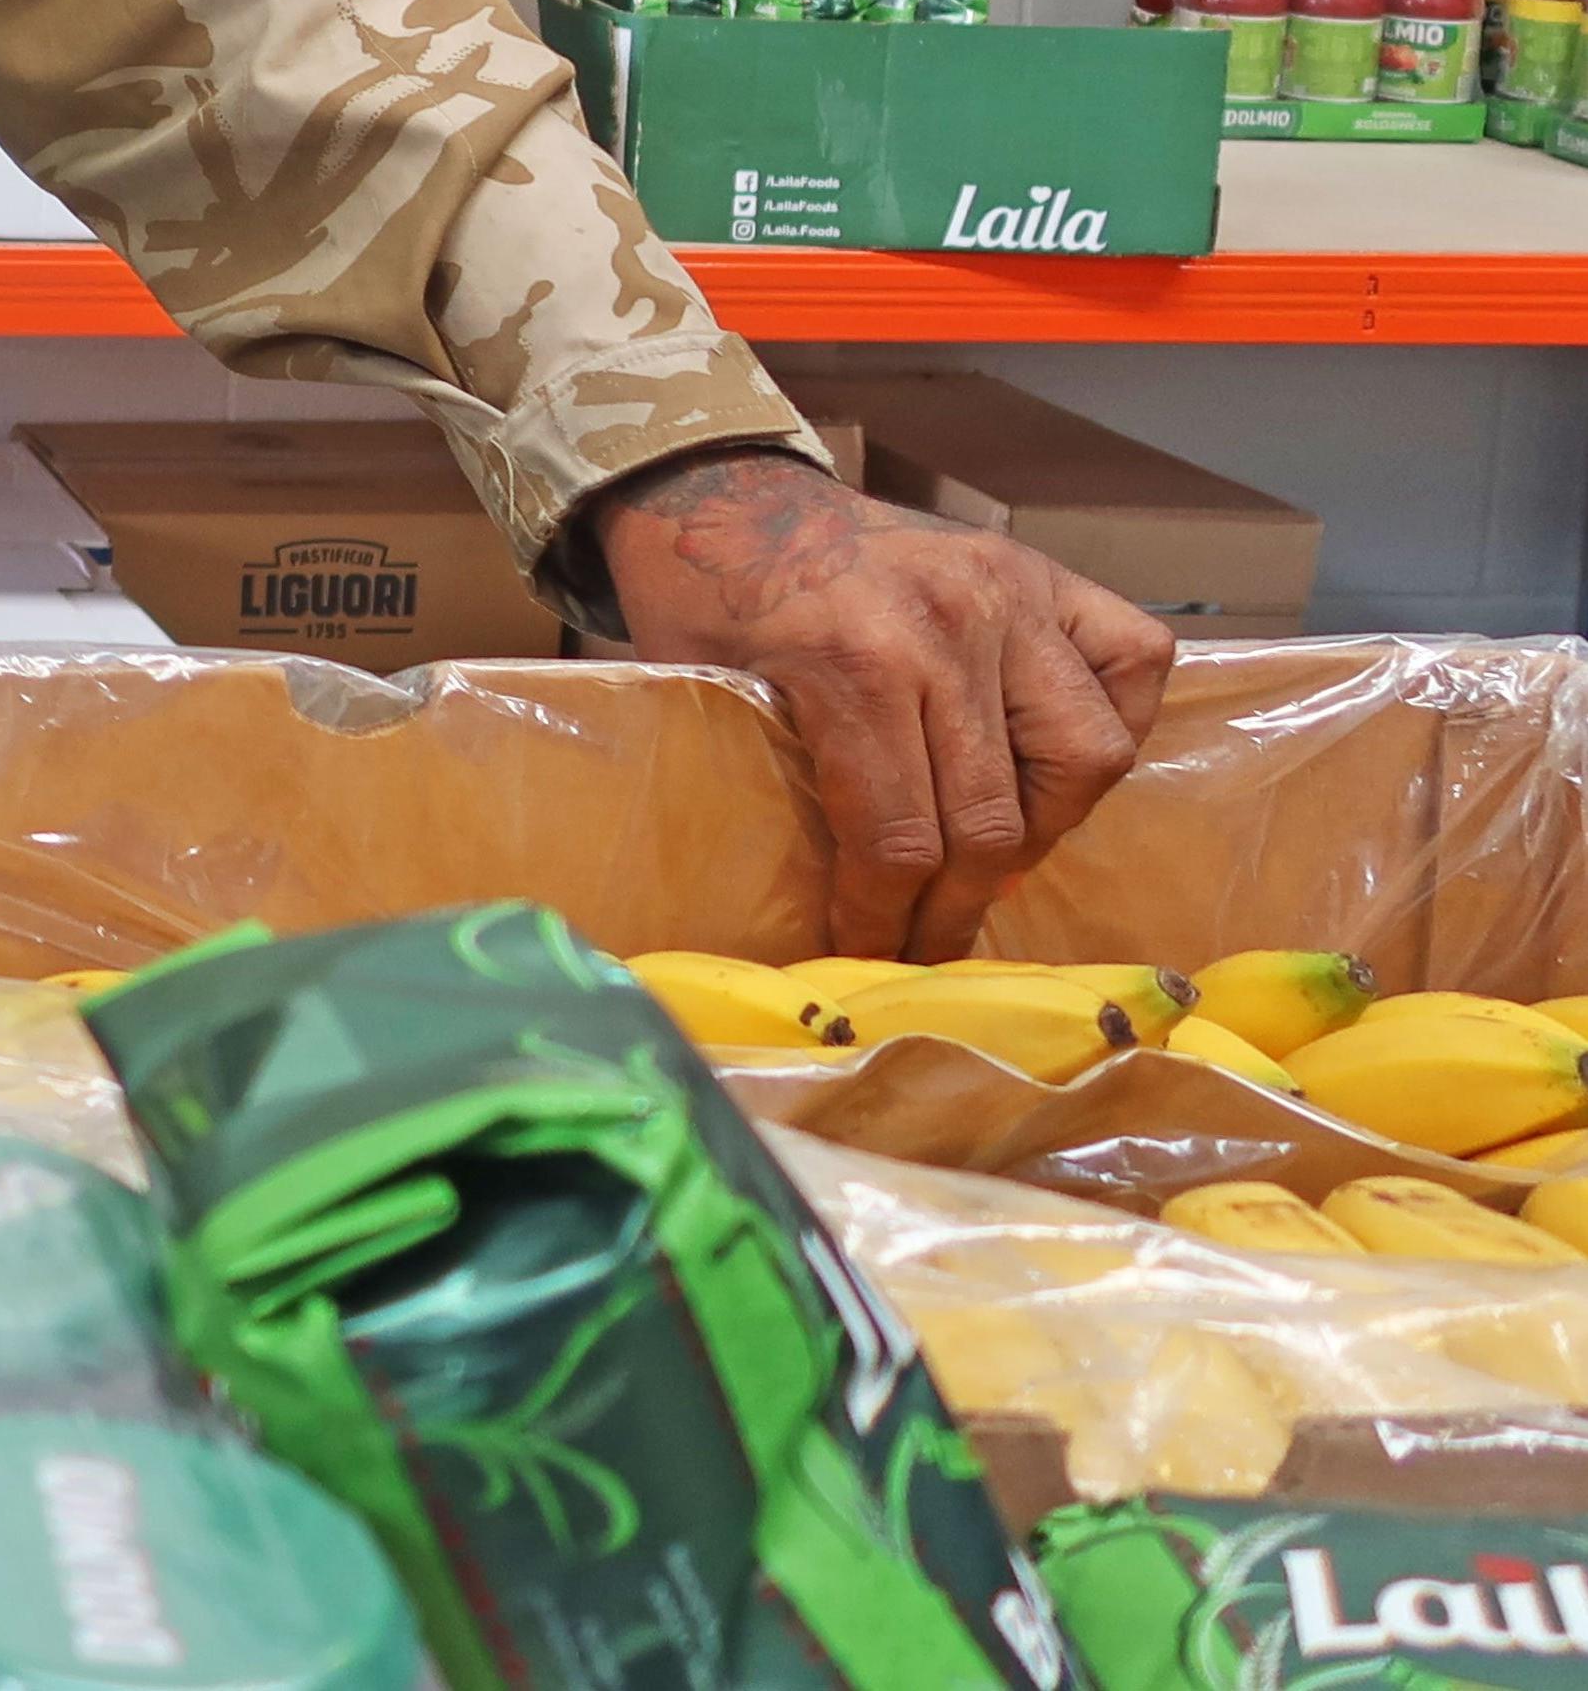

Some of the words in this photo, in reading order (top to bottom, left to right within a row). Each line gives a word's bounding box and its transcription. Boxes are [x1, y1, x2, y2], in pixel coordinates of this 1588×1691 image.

[1224, 110, 1291, 127] DOLMIO
[765, 174, 840, 189] /LailaFoods
[764, 199, 839, 213] /LailaFoods
[942, 184, 1110, 252] Laila
[290, 548, 375, 566] PASTIFICIO
[240, 573, 418, 618] LIGUORI
[305, 623, 347, 639] 1795
